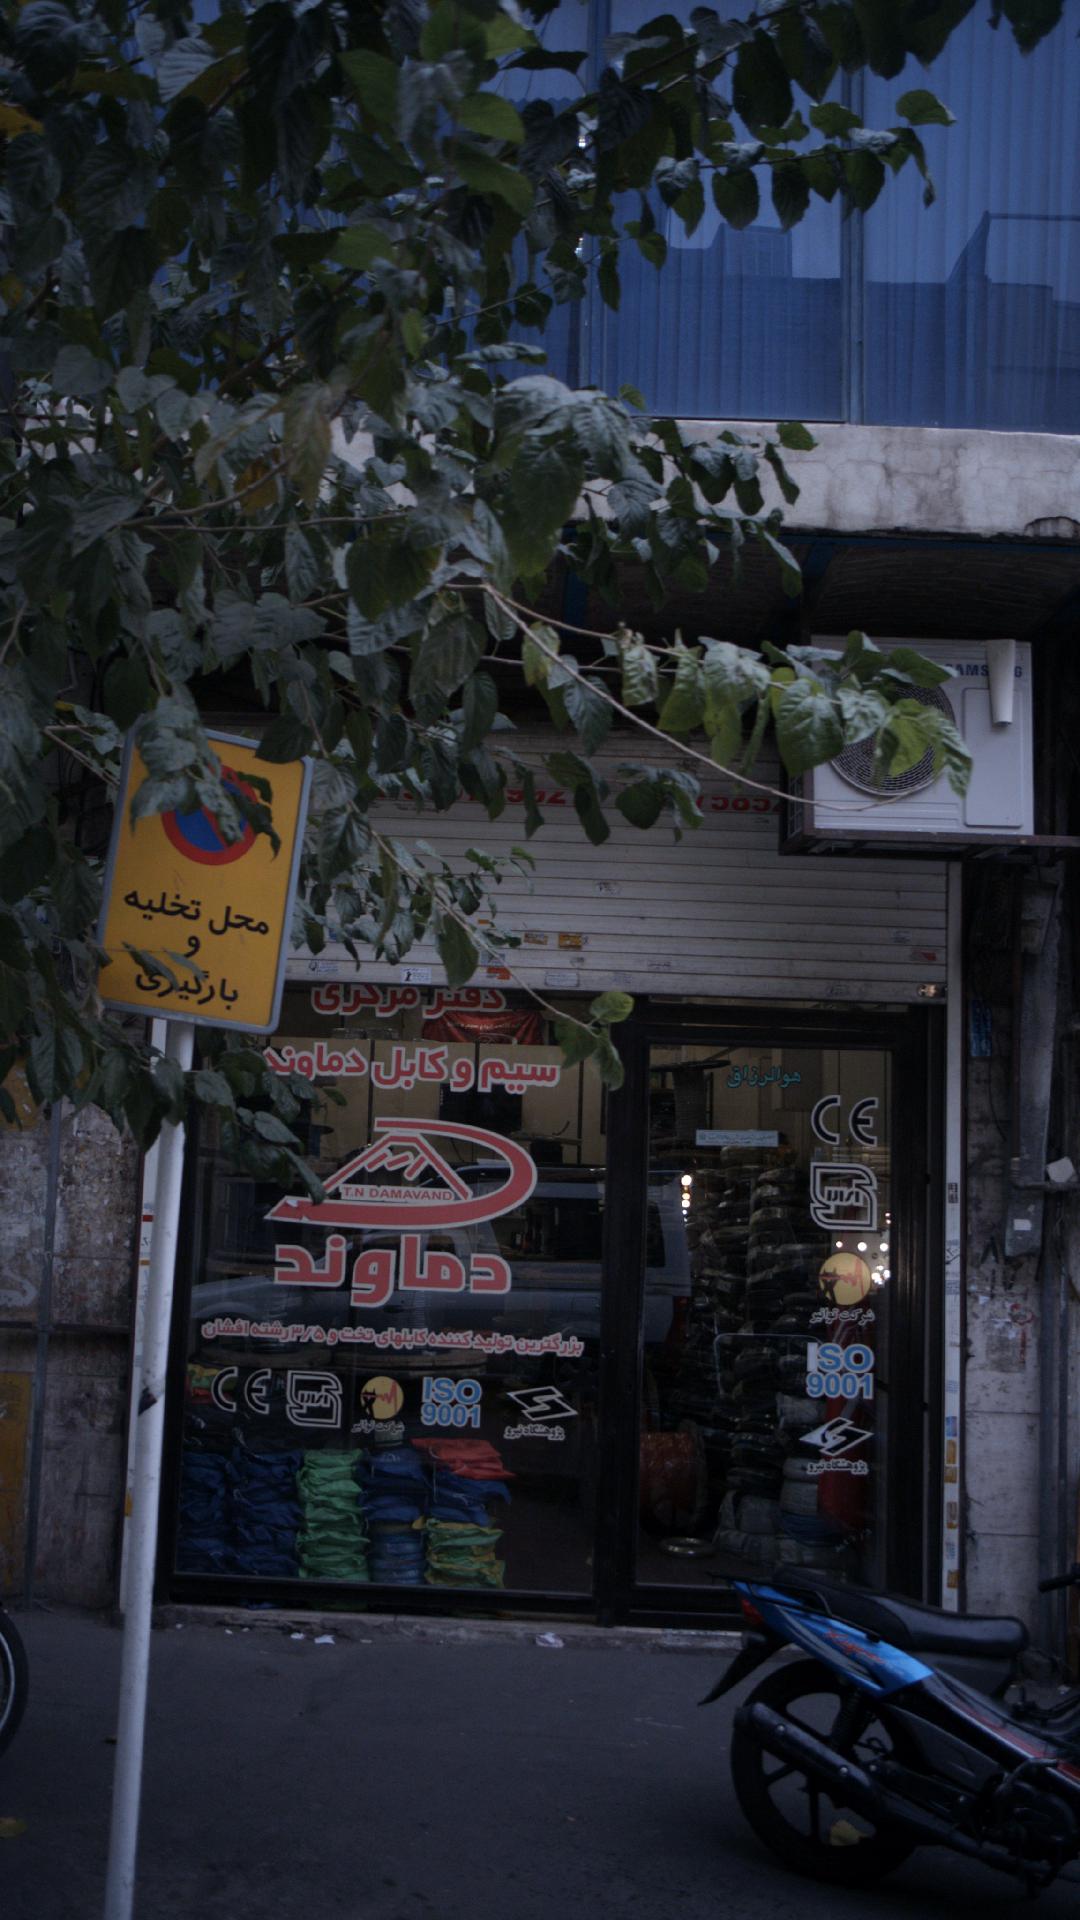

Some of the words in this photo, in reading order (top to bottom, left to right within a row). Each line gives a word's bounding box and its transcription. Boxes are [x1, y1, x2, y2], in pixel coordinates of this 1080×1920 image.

[945, 664, 1022, 678] AMSG
[124, 890, 201, 921] تخلیه
[209, 906, 270, 935] محل
[184, 934, 201, 957] و
[263, 1041, 369, 1081] دماوند
[371, 1046, 449, 1091] کابل
[449, 1058, 476, 1093] و
[477, 1059, 561, 1093] سیم
[811, 1094, 879, 1146] CE
[369, 1188, 452, 1200] DAMAVAND
[273, 1233, 512, 1308] دماوند
[201, 1317, 250, 1339] افشان
[250, 1320, 290, 1342] رشته
[326, 1331, 339, 1345] و
[339, 1326, 375, 1344] تخت
[375, 1327, 428, 1350] کابلهای
[428, 1330, 473, 1349] کننده
[472, 1332, 514, 1354] تولید
[515, 1331, 585, 1357] بزرگترین
[806, 1342, 875, 1373] ISO
[211, 1366, 272, 1415] CE
[421, 1376, 482, 1404] ISO
[805, 1371, 875, 1400] 9001
[420, 1402, 481, 1428] 9001
